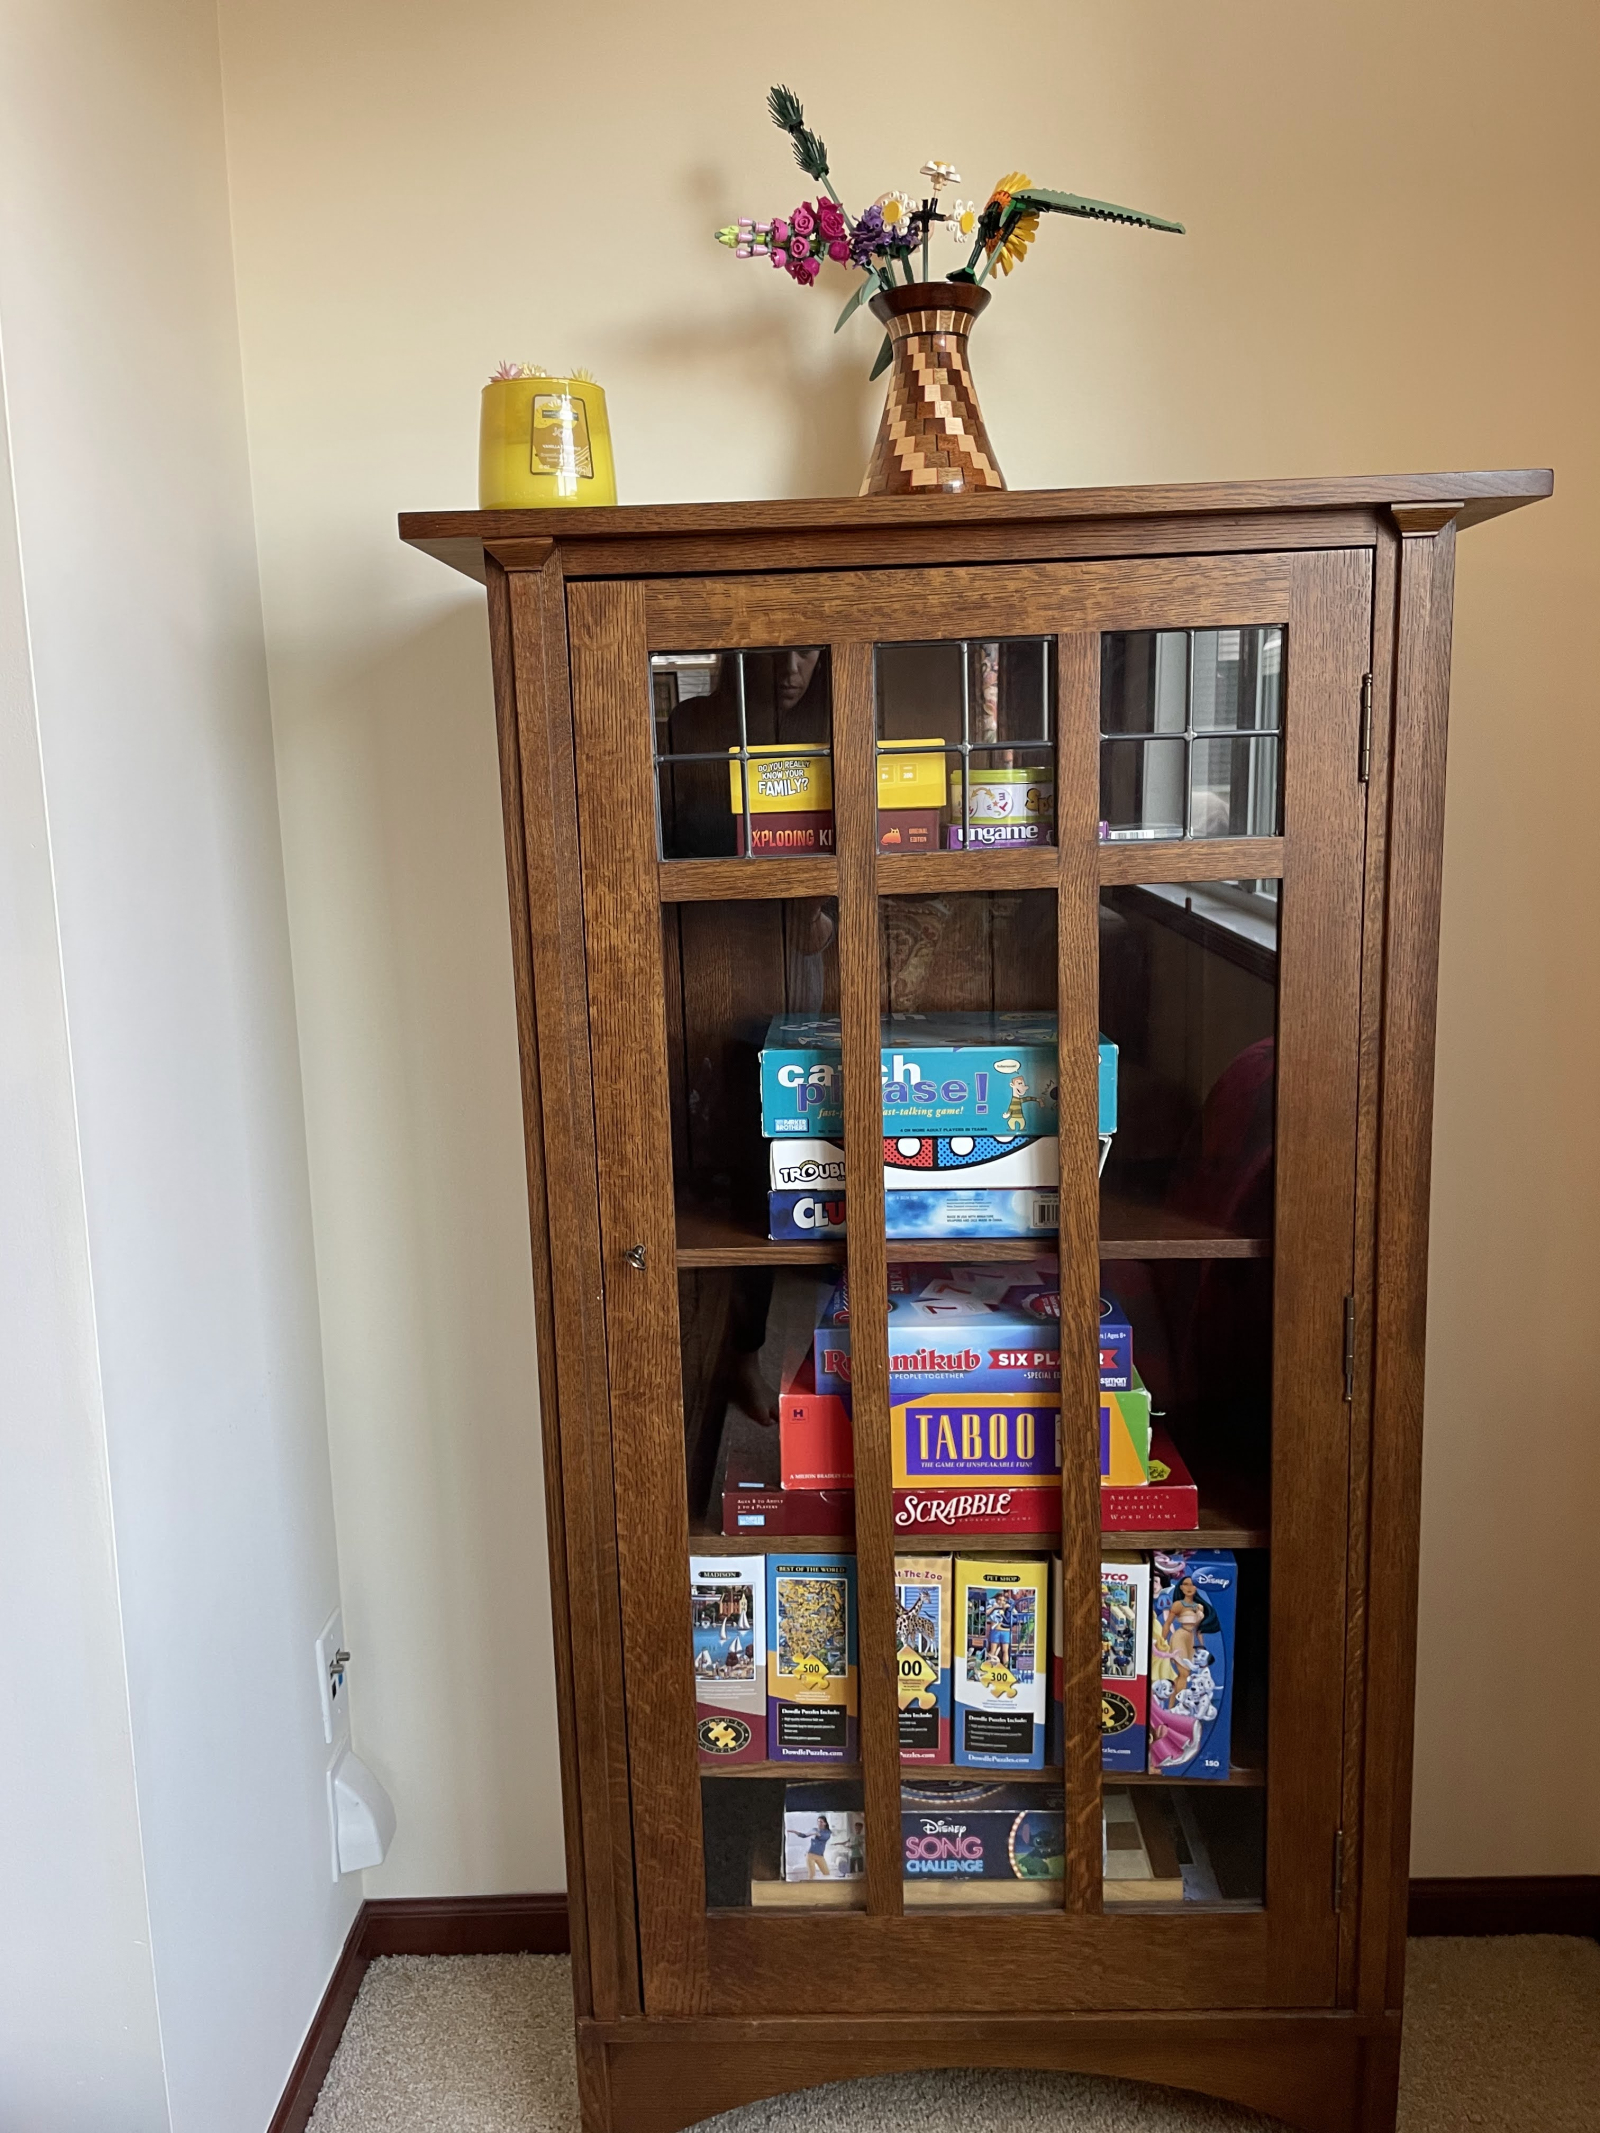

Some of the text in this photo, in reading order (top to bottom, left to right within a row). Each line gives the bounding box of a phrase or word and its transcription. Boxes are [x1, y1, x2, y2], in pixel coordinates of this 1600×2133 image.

[758, 760, 811, 772] DO YOU REALLY
[762, 769, 804, 779] KNOW YOUR
[758, 778, 809, 797] FAMILY?
[751, 829, 815, 847] XPLODING
[935, 1106, 964, 1118] game!
[779, 1162, 845, 1183] TROUBL
[793, 1197, 847, 1229] CLU
[1107, 1332, 1119, 1340] Ages
[998, 1353, 1028, 1366] SIX
[924, 1372, 964, 1380] TOGETHER
[915, 1413, 1035, 1460] TABOO
[895, 1493, 1011, 1526] SCRABBLE
[904, 1569, 921, 1578] The
[924, 1571, 943, 1581] Zoo
[1196, 1572, 1230, 1589] Disney
[803, 1664, 820, 1673] 500
[991, 1672, 1008, 1682] 300
[782, 1748, 843, 1757] DowdlePuzzles.com
[968, 1754, 1030, 1763] DowdlePuzzles.com
[1204, 1760, 1220, 1768] 150
[919, 1818, 967, 1837] Disney
[906, 1836, 983, 1859] SONG
[906, 1859, 984, 1873] CHALLENGE
